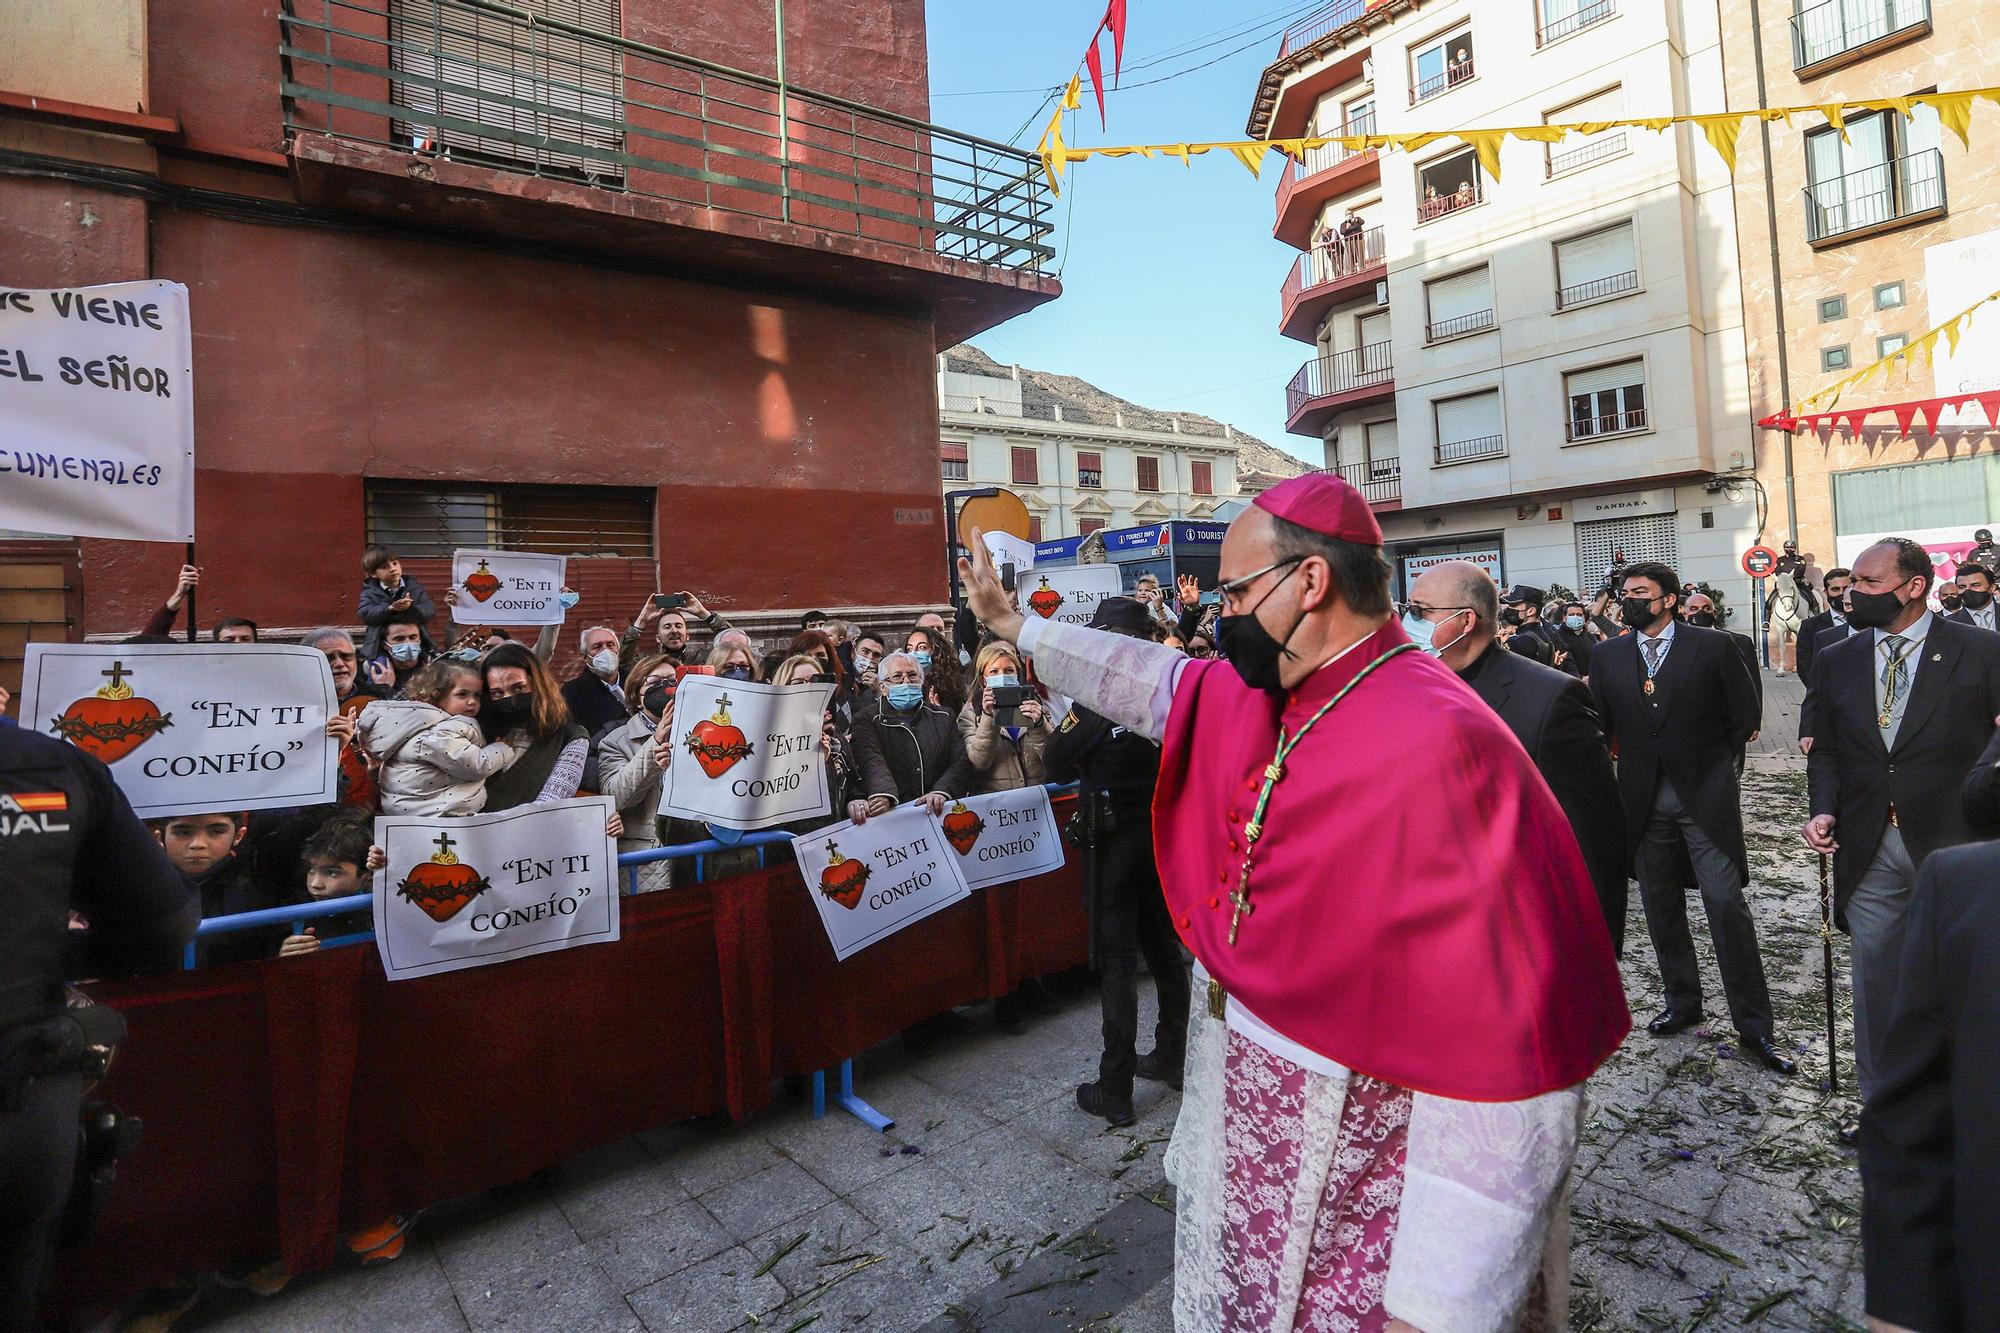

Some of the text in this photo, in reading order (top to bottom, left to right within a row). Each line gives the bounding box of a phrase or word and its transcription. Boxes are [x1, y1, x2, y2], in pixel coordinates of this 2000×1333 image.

[51, 292, 163, 331] VIENE
[58, 354, 171, 398] SEÑOR
[1596, 500, 1648, 511] DANDARA
[1125, 530, 1155, 541] TOURIST INFO
[1197, 531, 1225, 540] TOURIST
[1409, 553, 1498, 568] LIQUICIÓN
[509, 577, 552, 591] “EN TI
[1069, 590, 1111, 604] “EN TI
[493, 597, 552, 610] CONFÍO”
[191, 701, 306, 729] “EN TI
[766, 733, 811, 757] “EN TI
[143, 741, 304, 779] CONFÍO”
[731, 764, 809, 798] CONFÍO”
[989, 808, 1038, 828] “EN TI
[873, 837, 930, 869] “EN TI
[978, 831, 1041, 862] CONFÍO”
[502, 854, 591, 885] “EN TI
[869, 862, 937, 911] CONFÍO”
[470, 887, 592, 932] CONFÍO”
